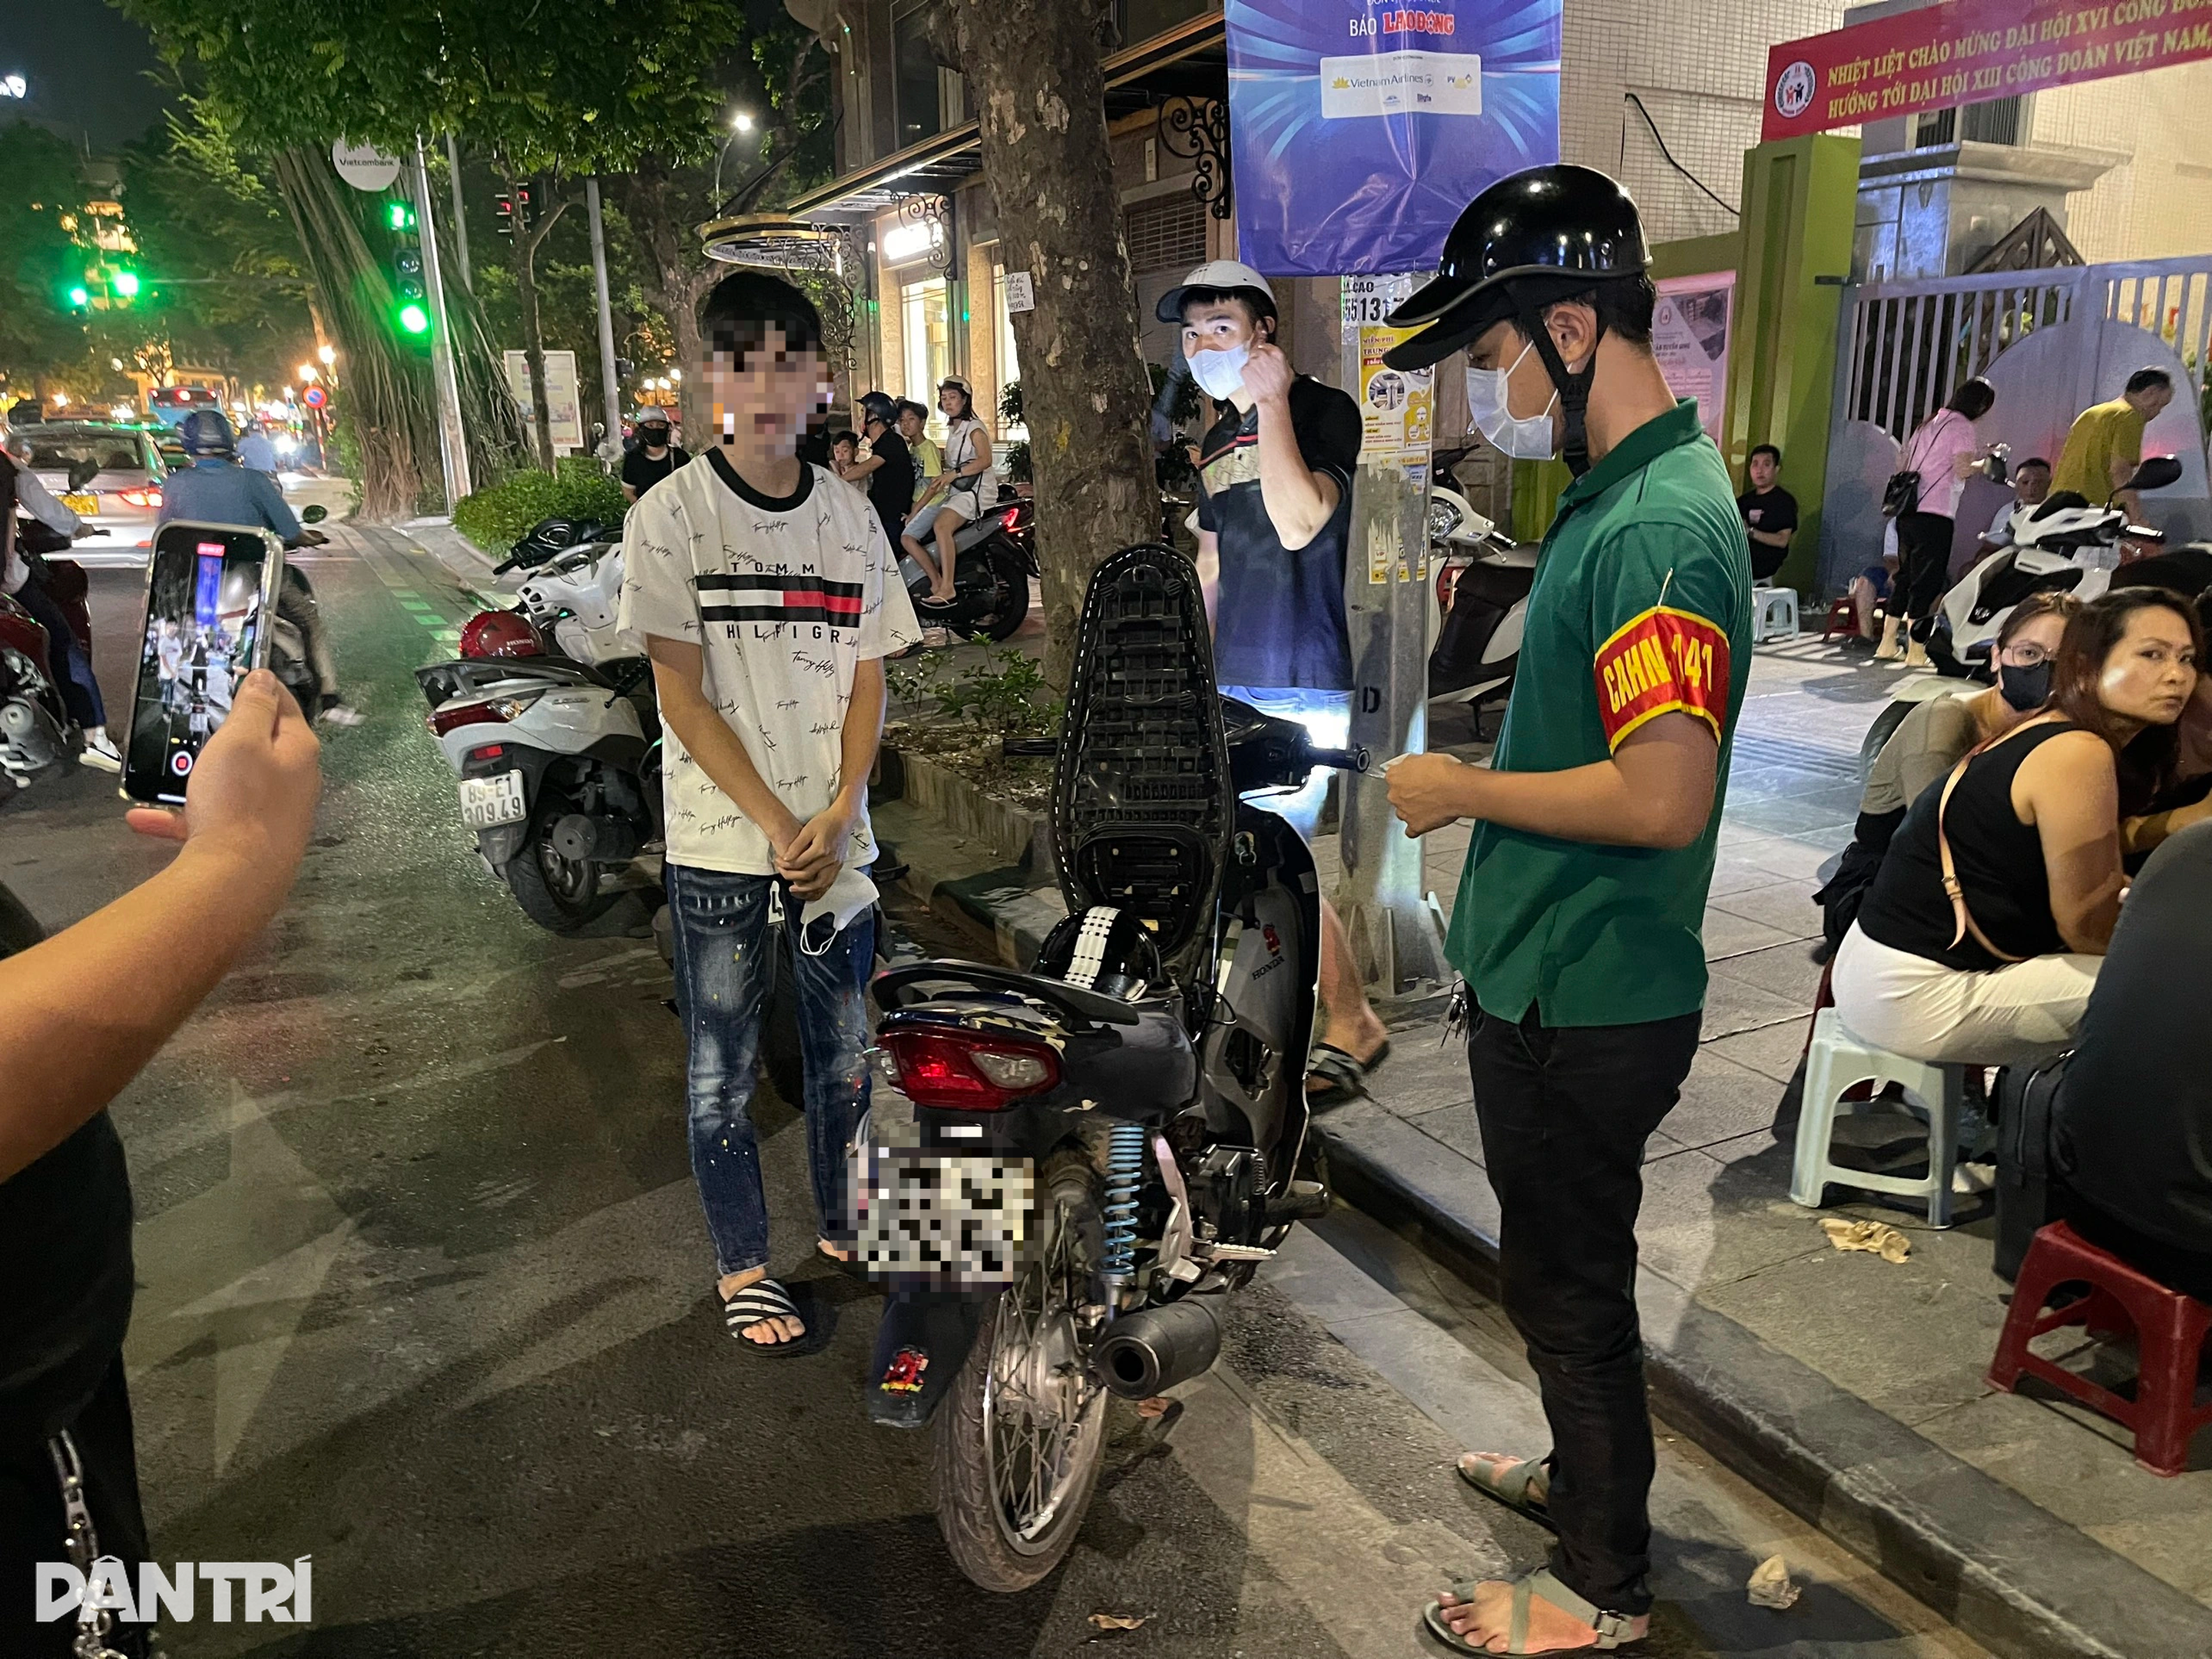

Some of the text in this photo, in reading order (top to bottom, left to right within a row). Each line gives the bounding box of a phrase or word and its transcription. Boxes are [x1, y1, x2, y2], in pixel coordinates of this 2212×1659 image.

[1349, 14, 1377, 37] BÁO
[1828, 55, 1870, 88] NHIỆT
[1873, 48, 1905, 80] LIỆT
[1909, 39, 1951, 69] CHÀO
[1955, 29, 2001, 59] MỪNG
[2040, 11, 2072, 45] HỘI
[2075, 6, 2108, 35] XVI
[1350, 75, 1423, 88] Vietnam Airlines
[1828, 89, 1878, 119] HƯỚNG
[1882, 81, 1906, 108] TỚI
[1941, 68, 1969, 99] HỘI
[1972, 65, 2002, 91] XIII
[2005, 55, 2052, 84] CÔNG
[2057, 41, 2108, 74] ĐOÀN
[2114, 29, 2158, 66] VIỆT
[339, 157, 395, 167] Vietcombank
[1353, 281, 1374, 293] CAO
[1603, 634, 1713, 714] CAHN 141
[1252, 955, 1285, 981] HONDA
